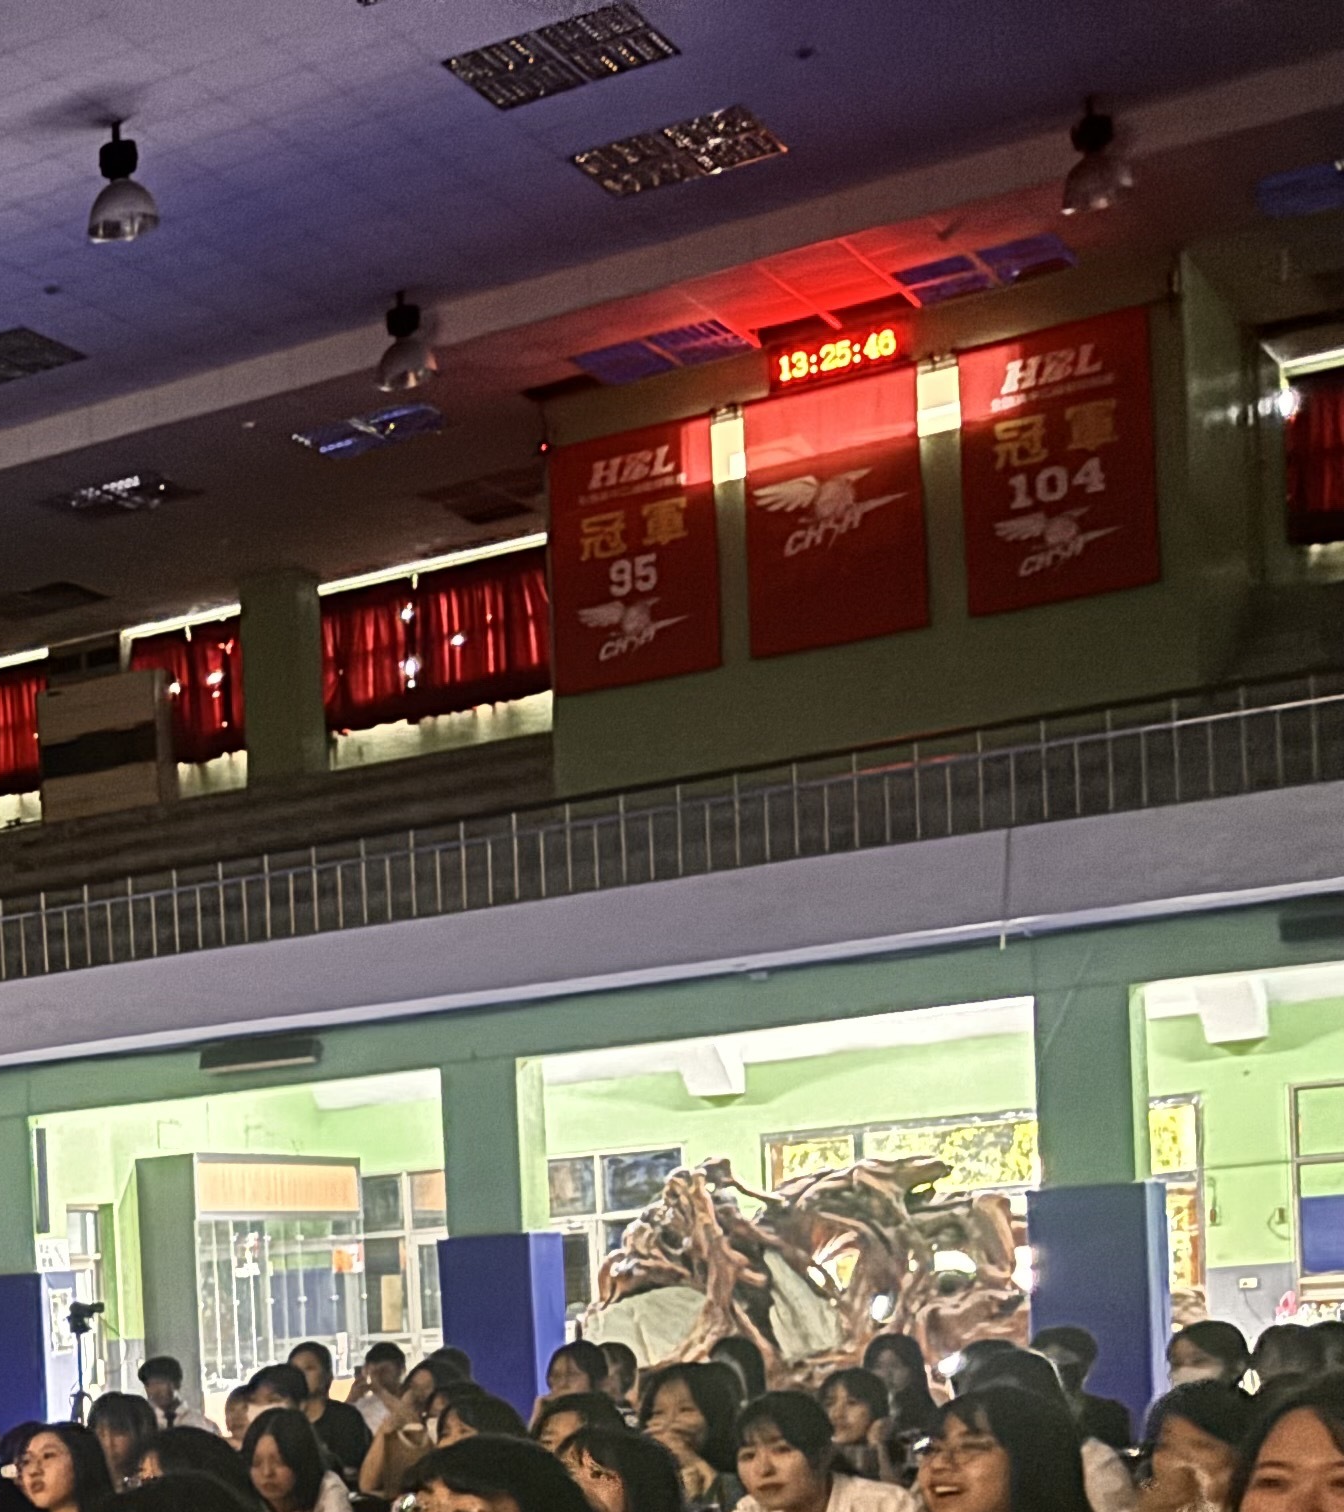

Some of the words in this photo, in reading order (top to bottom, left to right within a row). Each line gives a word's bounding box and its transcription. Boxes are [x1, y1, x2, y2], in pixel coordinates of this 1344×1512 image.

[999, 343, 1103, 395] HBL
[588, 445, 675, 490] HBL
[1007, 456, 1107, 510] 104
[608, 553, 658, 597] 95
